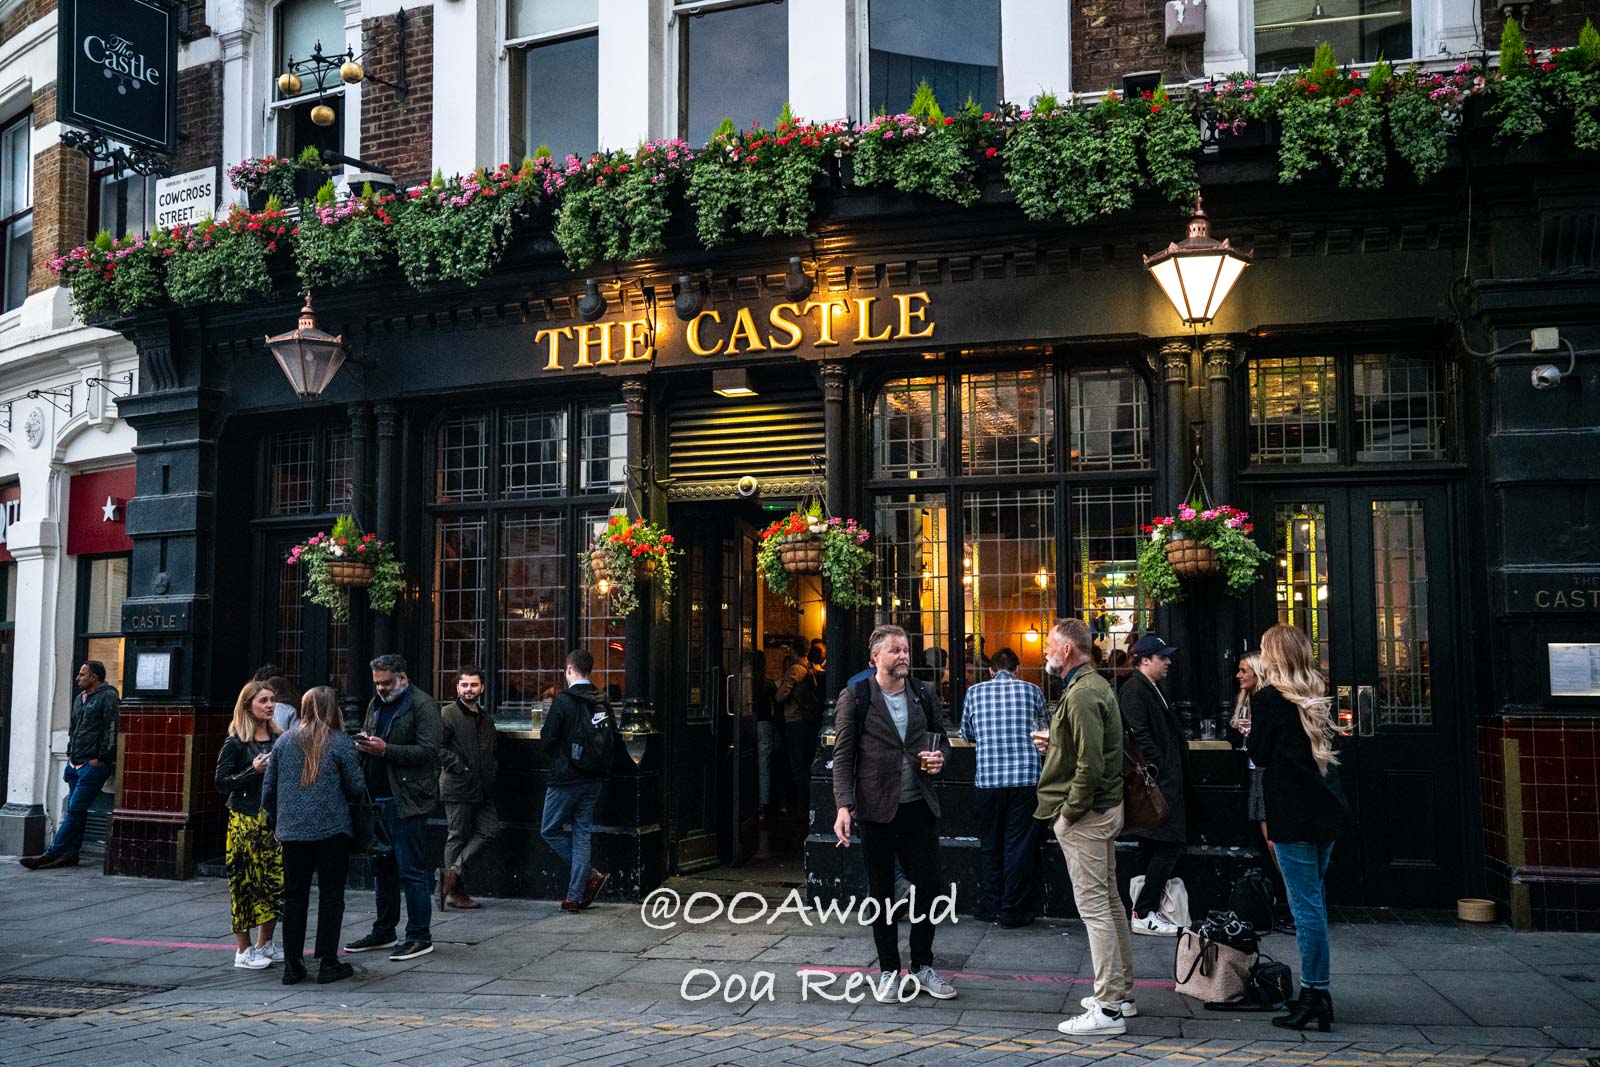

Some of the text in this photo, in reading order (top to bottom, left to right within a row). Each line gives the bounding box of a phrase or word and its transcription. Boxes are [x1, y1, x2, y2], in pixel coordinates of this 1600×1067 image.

[107, 34, 134, 58] The
[83, 35, 160, 86] Castle
[159, 183, 212, 207] COWCROSS
[159, 206, 195, 226] STREET
[534, 290, 936, 371] THE CASTLE
[1573, 576, 1600, 585] THE
[132, 614, 177, 629] CASTLE
